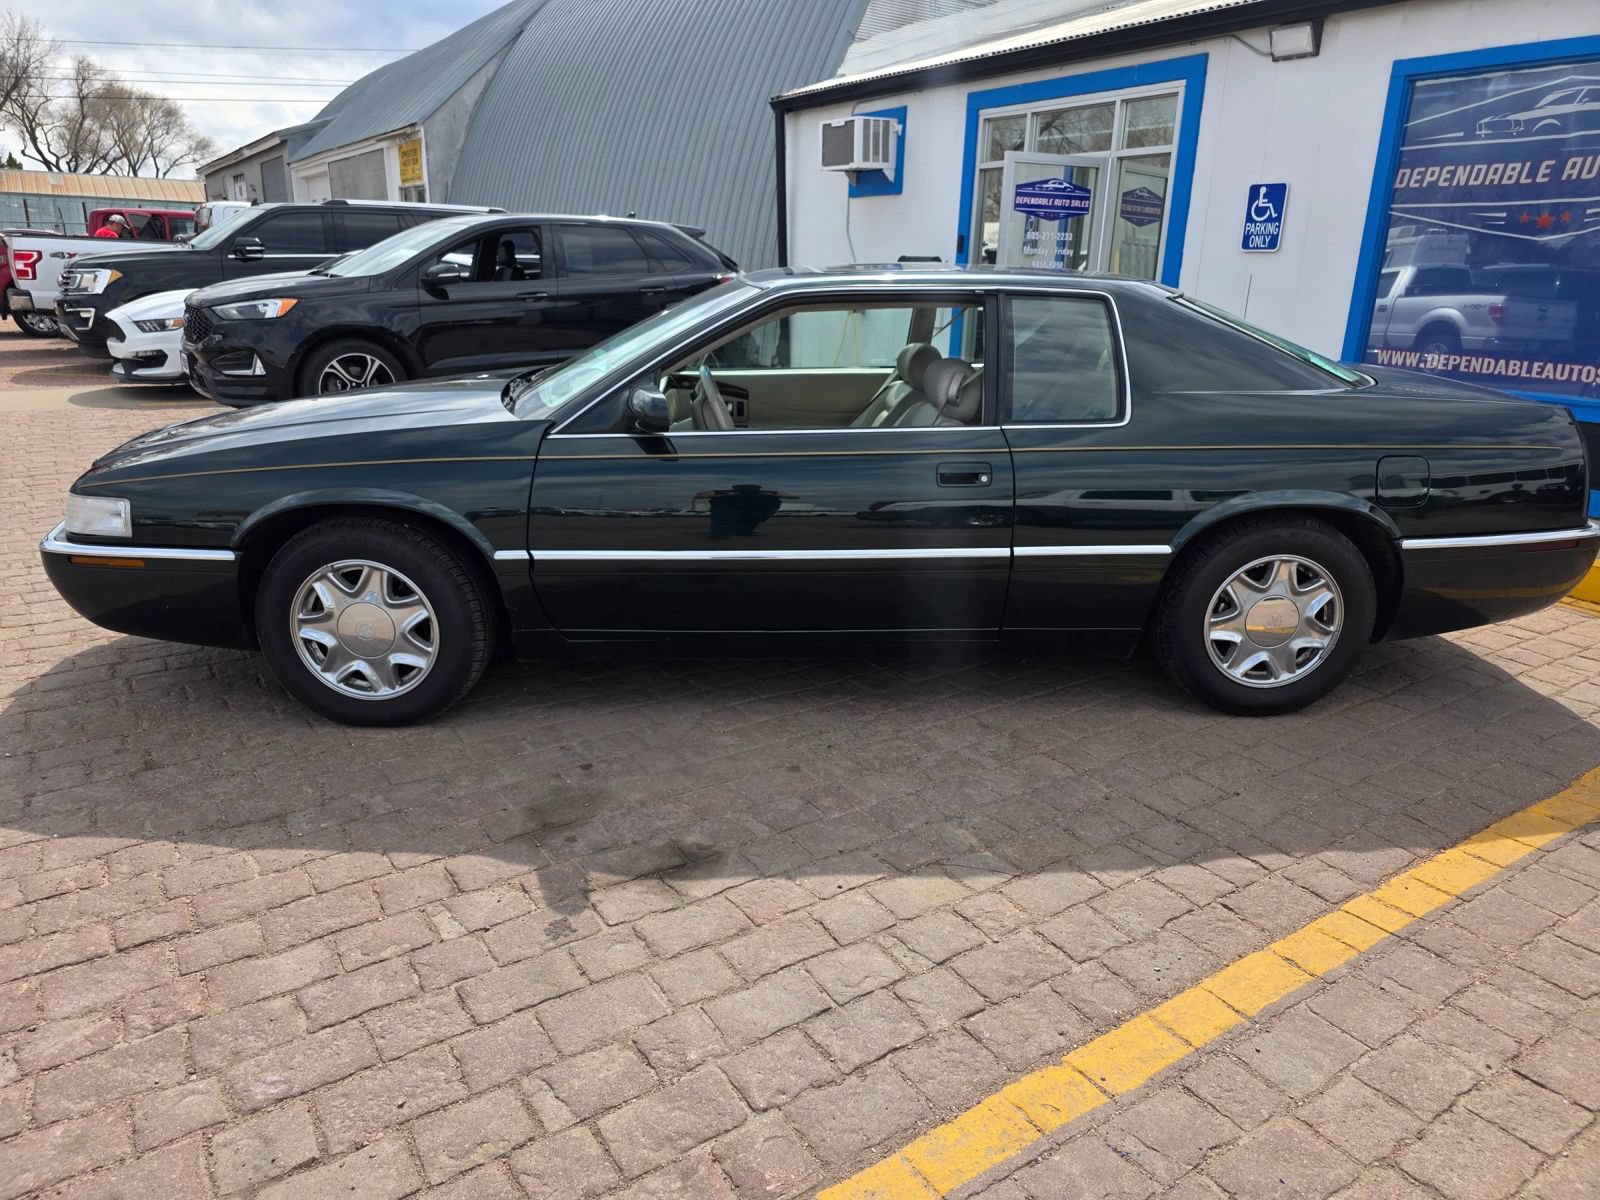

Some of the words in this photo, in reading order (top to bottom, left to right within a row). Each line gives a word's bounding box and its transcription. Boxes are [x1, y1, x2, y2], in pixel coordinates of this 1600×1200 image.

[1394, 160, 1556, 188] DEPENDABLE
[1015, 196, 1053, 206] DEPENDABLE
[1054, 199, 1070, 207] AUTO
[1070, 200, 1090, 208] SALES
[1245, 222, 1279, 235] PARKING
[1249, 235, 1271, 248] ONLY
[1055, 246, 1074, 257] Friday
